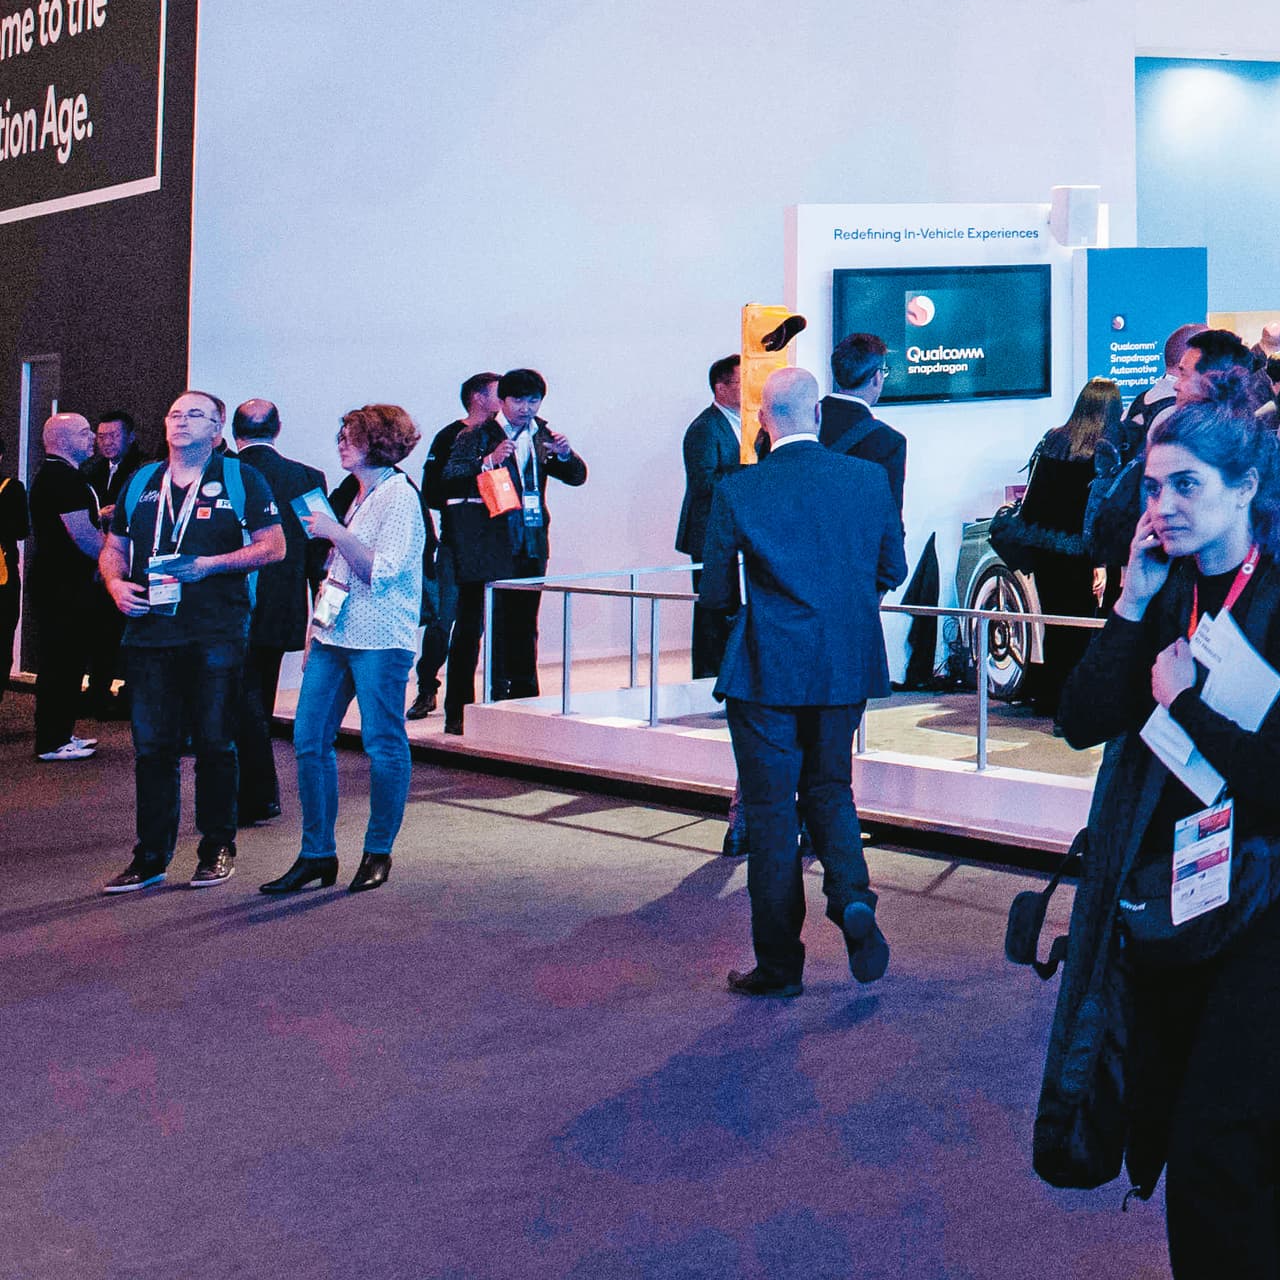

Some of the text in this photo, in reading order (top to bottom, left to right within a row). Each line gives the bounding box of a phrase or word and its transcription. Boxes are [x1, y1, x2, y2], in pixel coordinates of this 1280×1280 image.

[40, 84, 93, 163] Age.
[834, 228, 1039, 242] Redefining In-Vehicle Experiences
[906, 345, 984, 363] Qualcomm
[908, 362, 968, 375] snapdragon
[1110, 365, 1158, 374] Automotive
